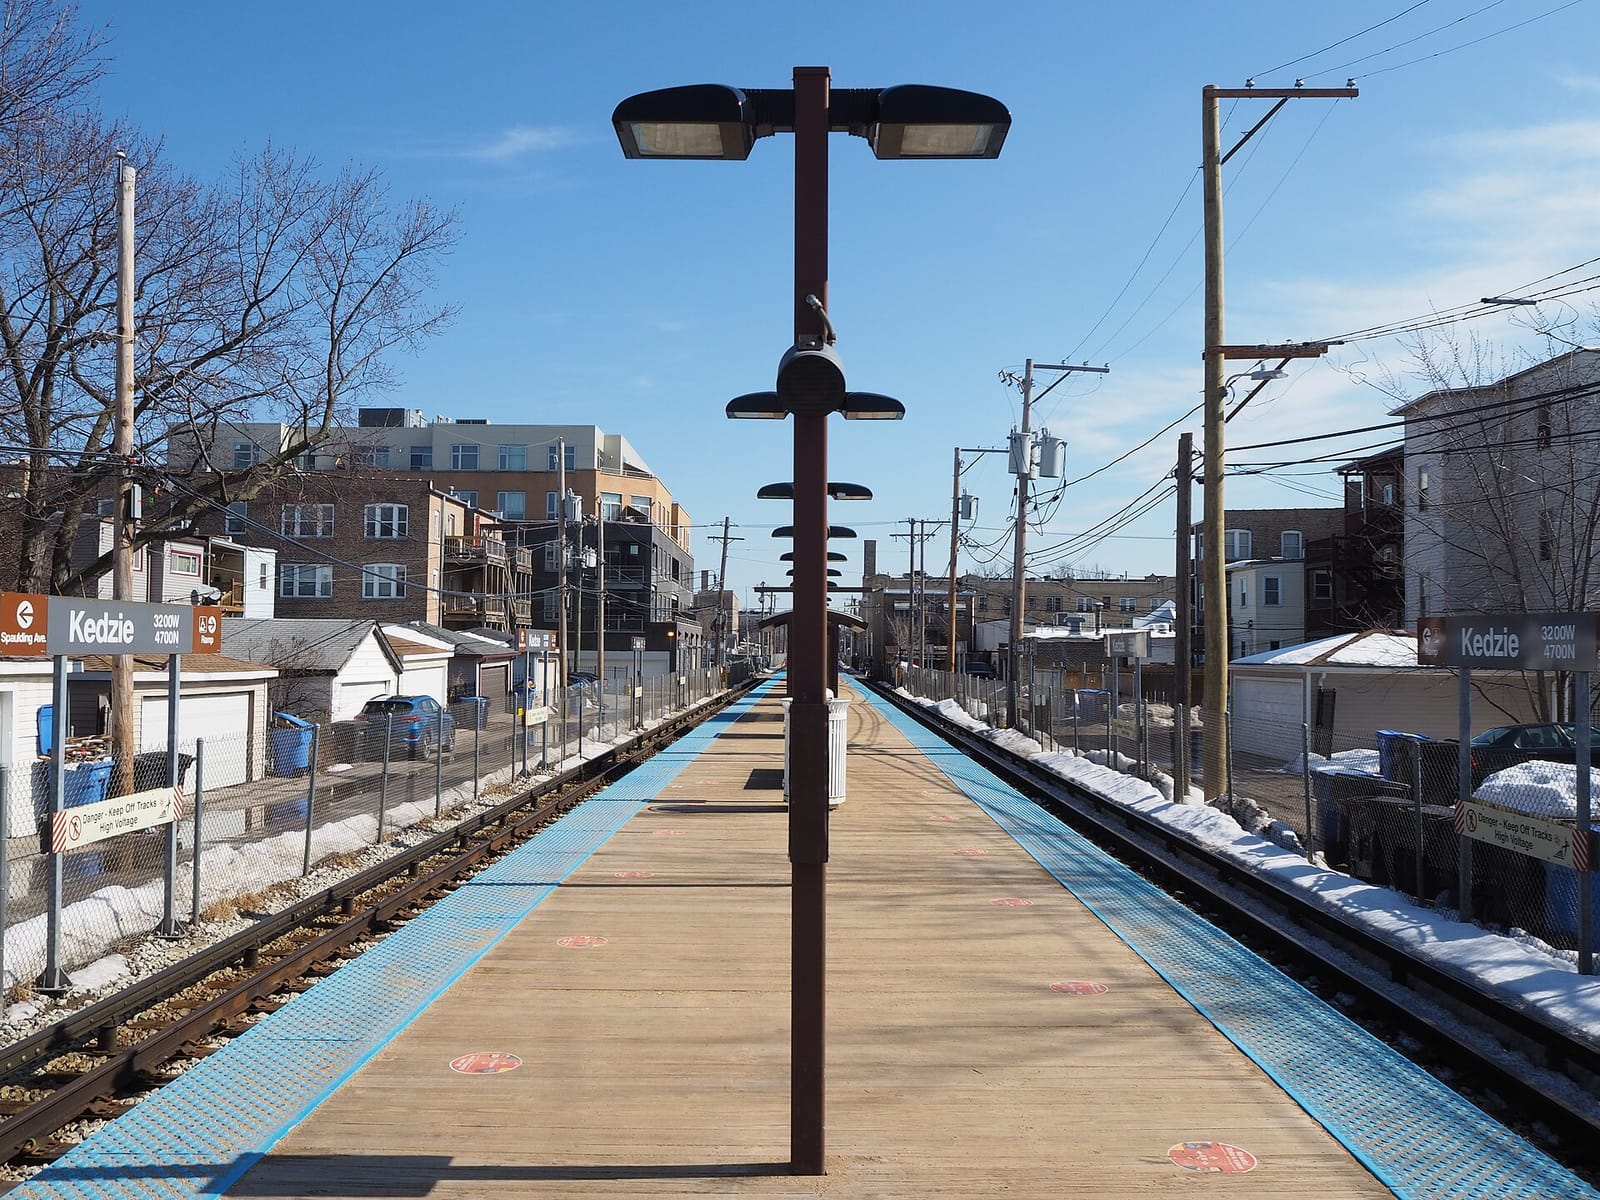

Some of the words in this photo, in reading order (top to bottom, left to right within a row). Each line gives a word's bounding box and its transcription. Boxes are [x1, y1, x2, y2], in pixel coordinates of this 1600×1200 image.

[69, 610, 134, 644] Kedzie
[153, 614, 180, 628] 3200W
[1, 631, 33, 645] Spaulding
[34, 632, 47, 643] Ave.
[154, 630, 179, 645] 4700N
[1541, 624, 1575, 640] 3200W
[1461, 627, 1519, 657] Kedzie
[1543, 644, 1575, 659] 4700N
[82, 812, 104, 825] Danger
[109, 807, 124, 817] Keep
[125, 803, 135, 814] Off
[137, 799, 157, 810] Tracks
[99, 822, 113, 833] High
[115, 816, 138, 829] Voltage
[1478, 812, 1498, 828] Danger
[1503, 821, 1518, 834] Keep
[1520, 824, 1530, 836] Off
[1531, 827, 1553, 842] Tracks
[1495, 829, 1508, 844] High
[1510, 833, 1534, 851] Voltage
